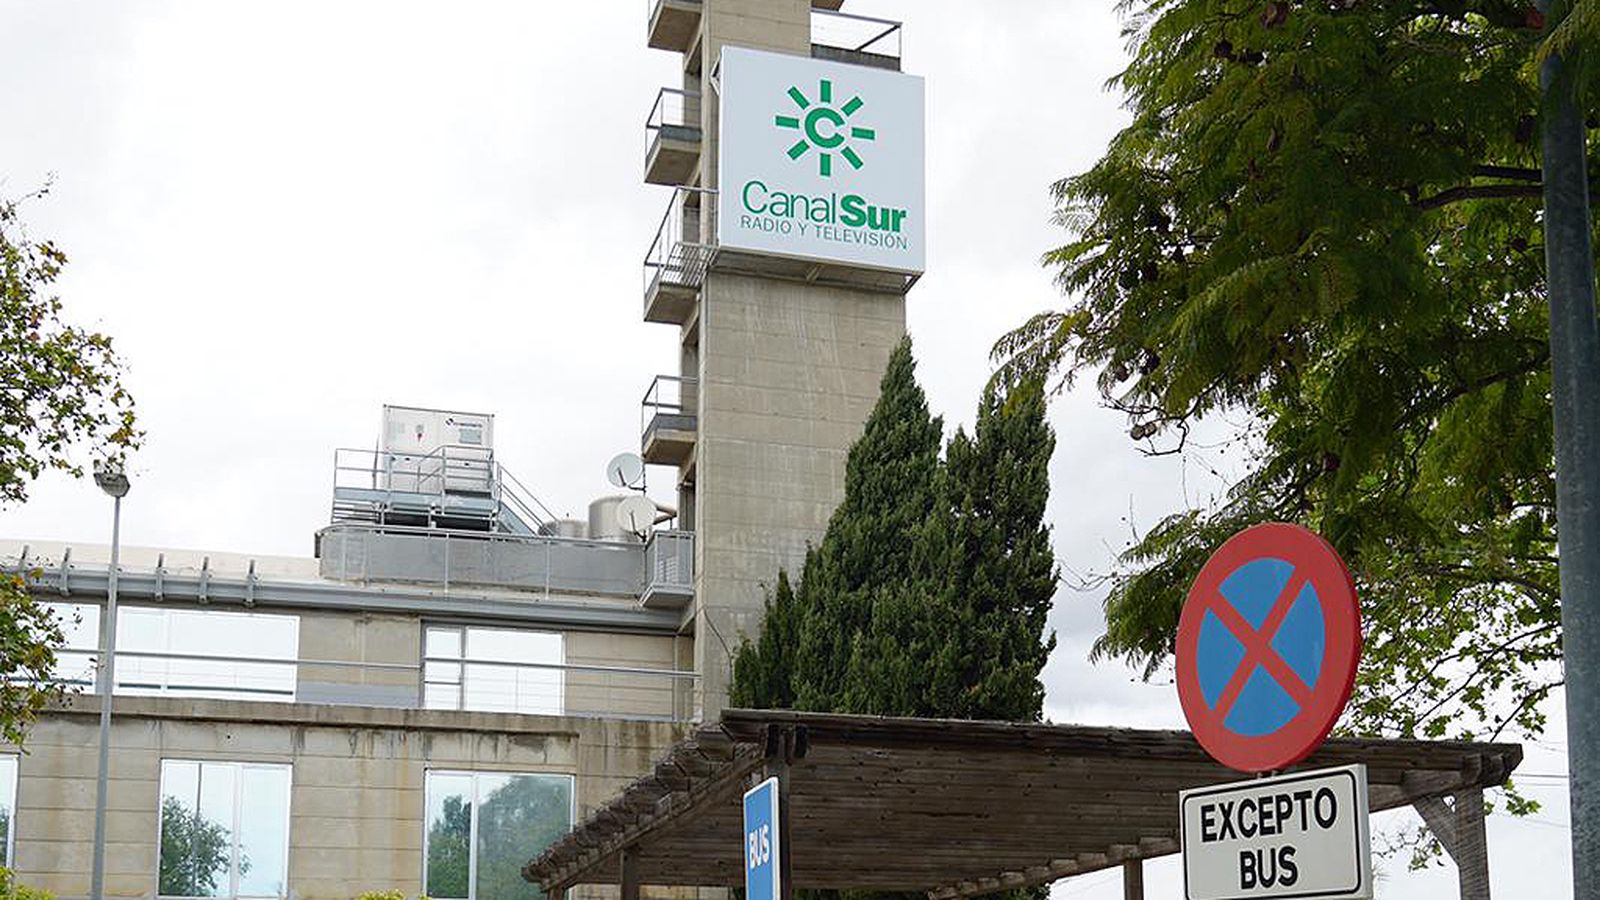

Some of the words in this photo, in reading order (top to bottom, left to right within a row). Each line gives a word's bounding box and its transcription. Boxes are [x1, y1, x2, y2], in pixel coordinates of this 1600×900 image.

[740, 215, 792, 234] RADIO
[798, 221, 807, 236] Y
[1201, 787, 1337, 842] EXCEPTO
[749, 824, 769, 869] BUS
[1240, 846, 1298, 889] BUS
